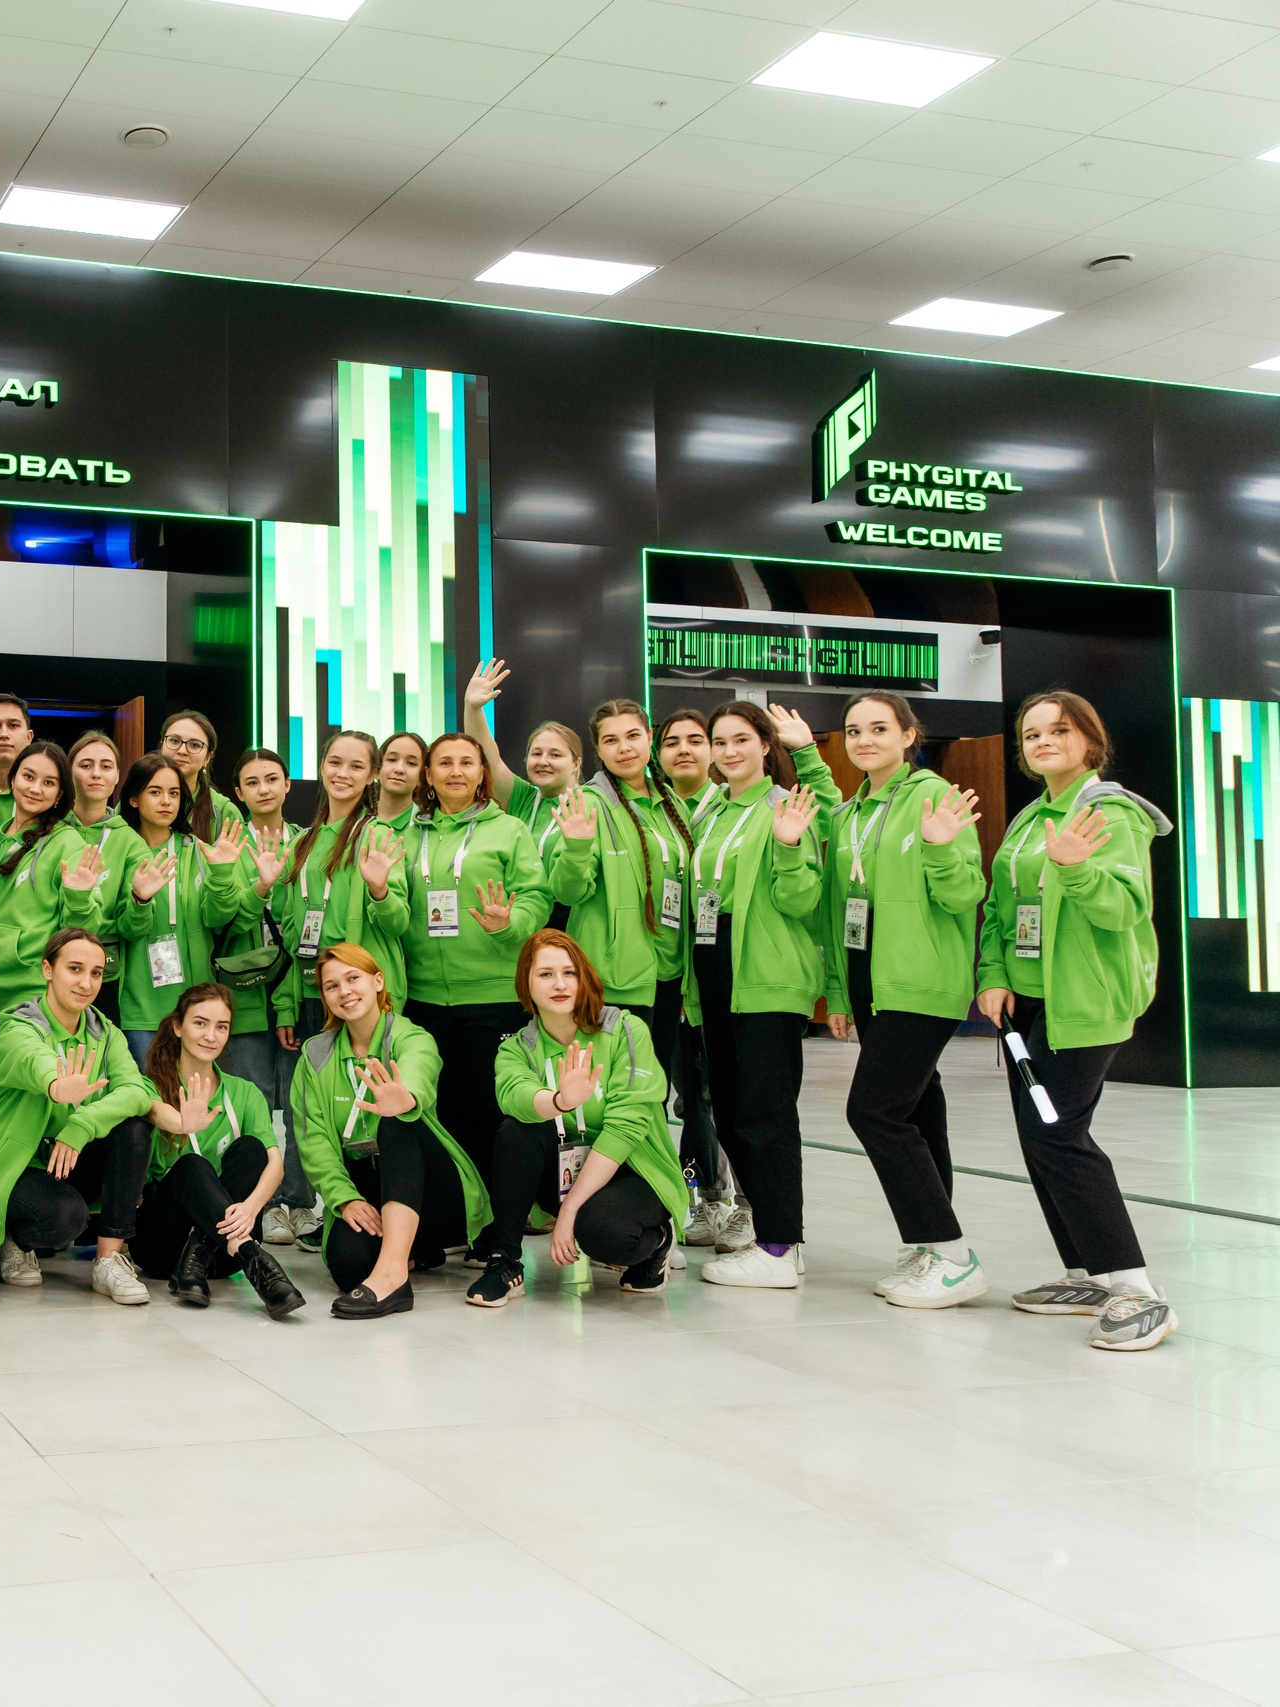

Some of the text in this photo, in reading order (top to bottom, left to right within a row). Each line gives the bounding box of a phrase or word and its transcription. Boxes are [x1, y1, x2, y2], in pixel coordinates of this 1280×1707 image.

[867, 459, 1024, 493] PHYGITAL
[867, 484, 987, 512] GAMES
[836, 520, 1003, 553] WELCOME
